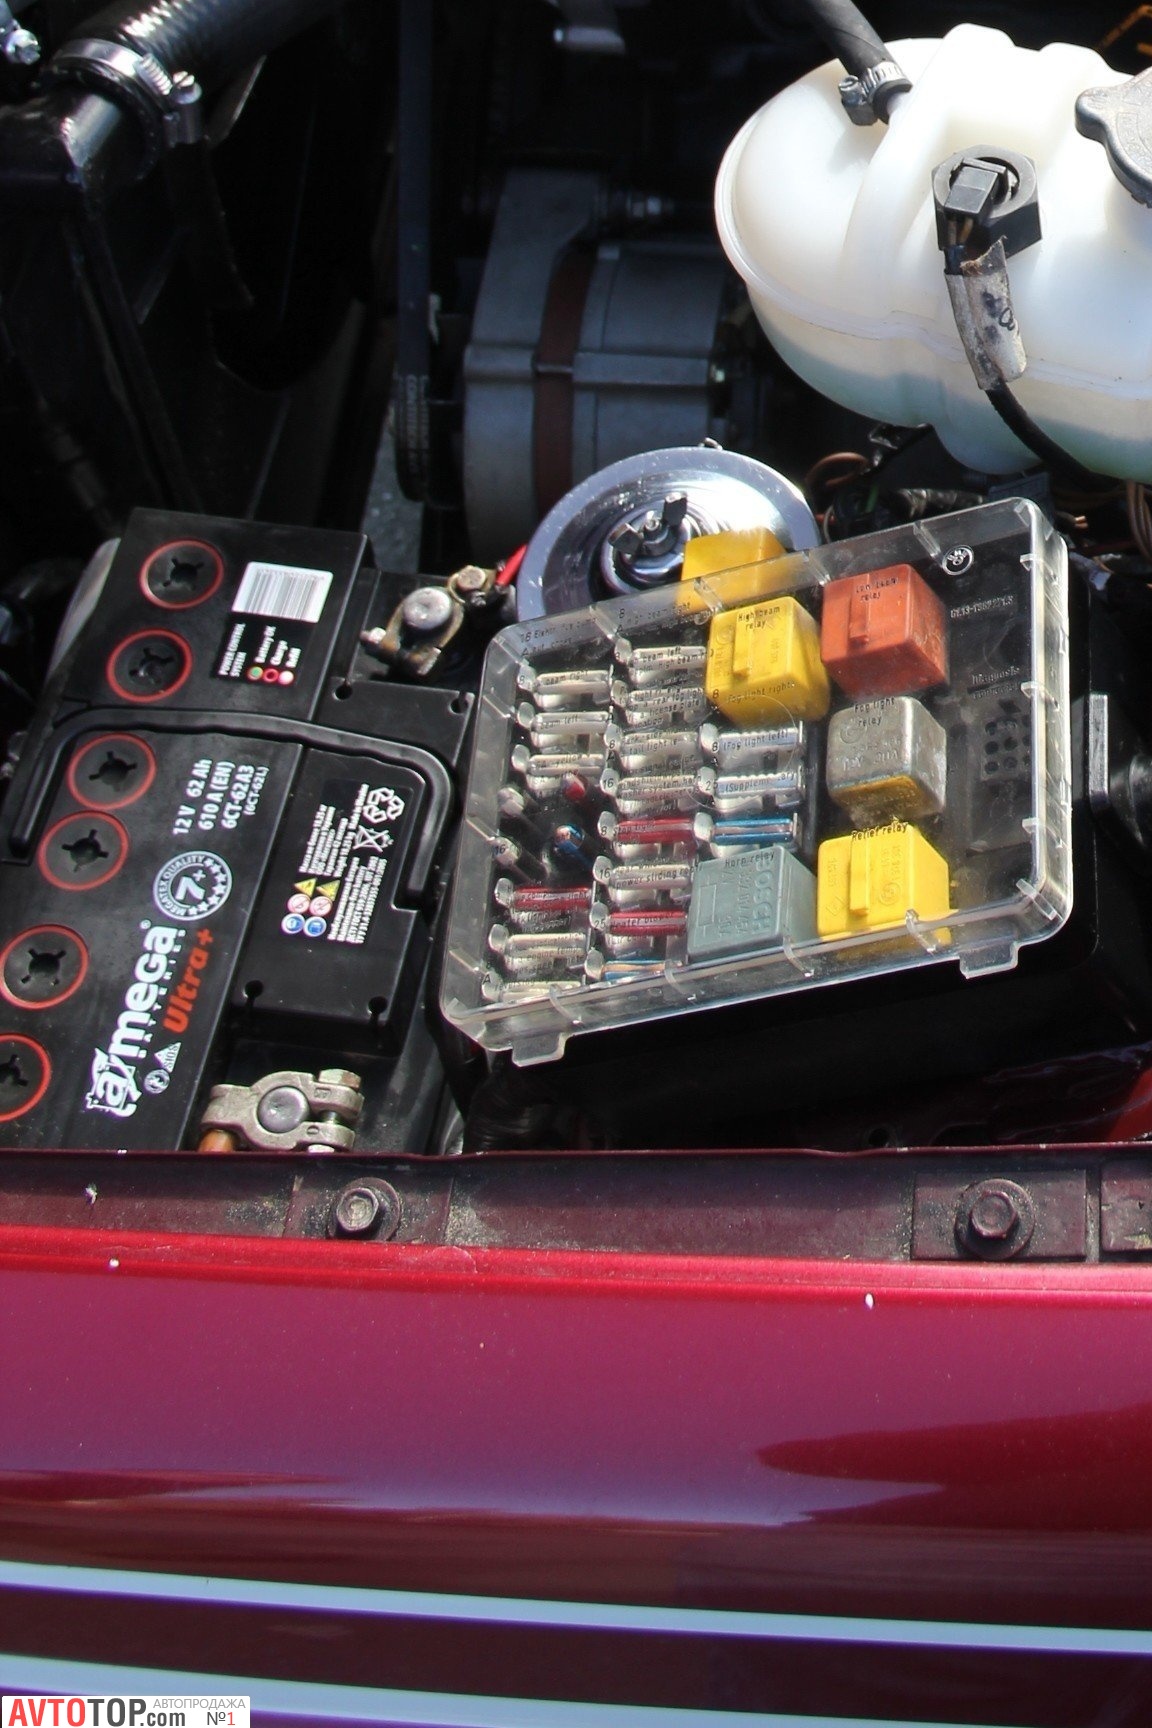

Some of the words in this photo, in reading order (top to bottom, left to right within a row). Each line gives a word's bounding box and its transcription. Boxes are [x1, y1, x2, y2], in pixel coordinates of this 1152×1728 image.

[854, 702, 872, 715] Fog
[873, 696, 896, 711] light
[192, 758, 213, 778] Ah
[186, 779, 206, 799] 62
[198, 803, 221, 831] 610
[210, 761, 236, 791] (EN)
[178, 805, 196, 817] V
[172, 818, 193, 836] 12
[164, 855, 206, 880] QUALITY
[158, 879, 188, 917] MEGATEX
